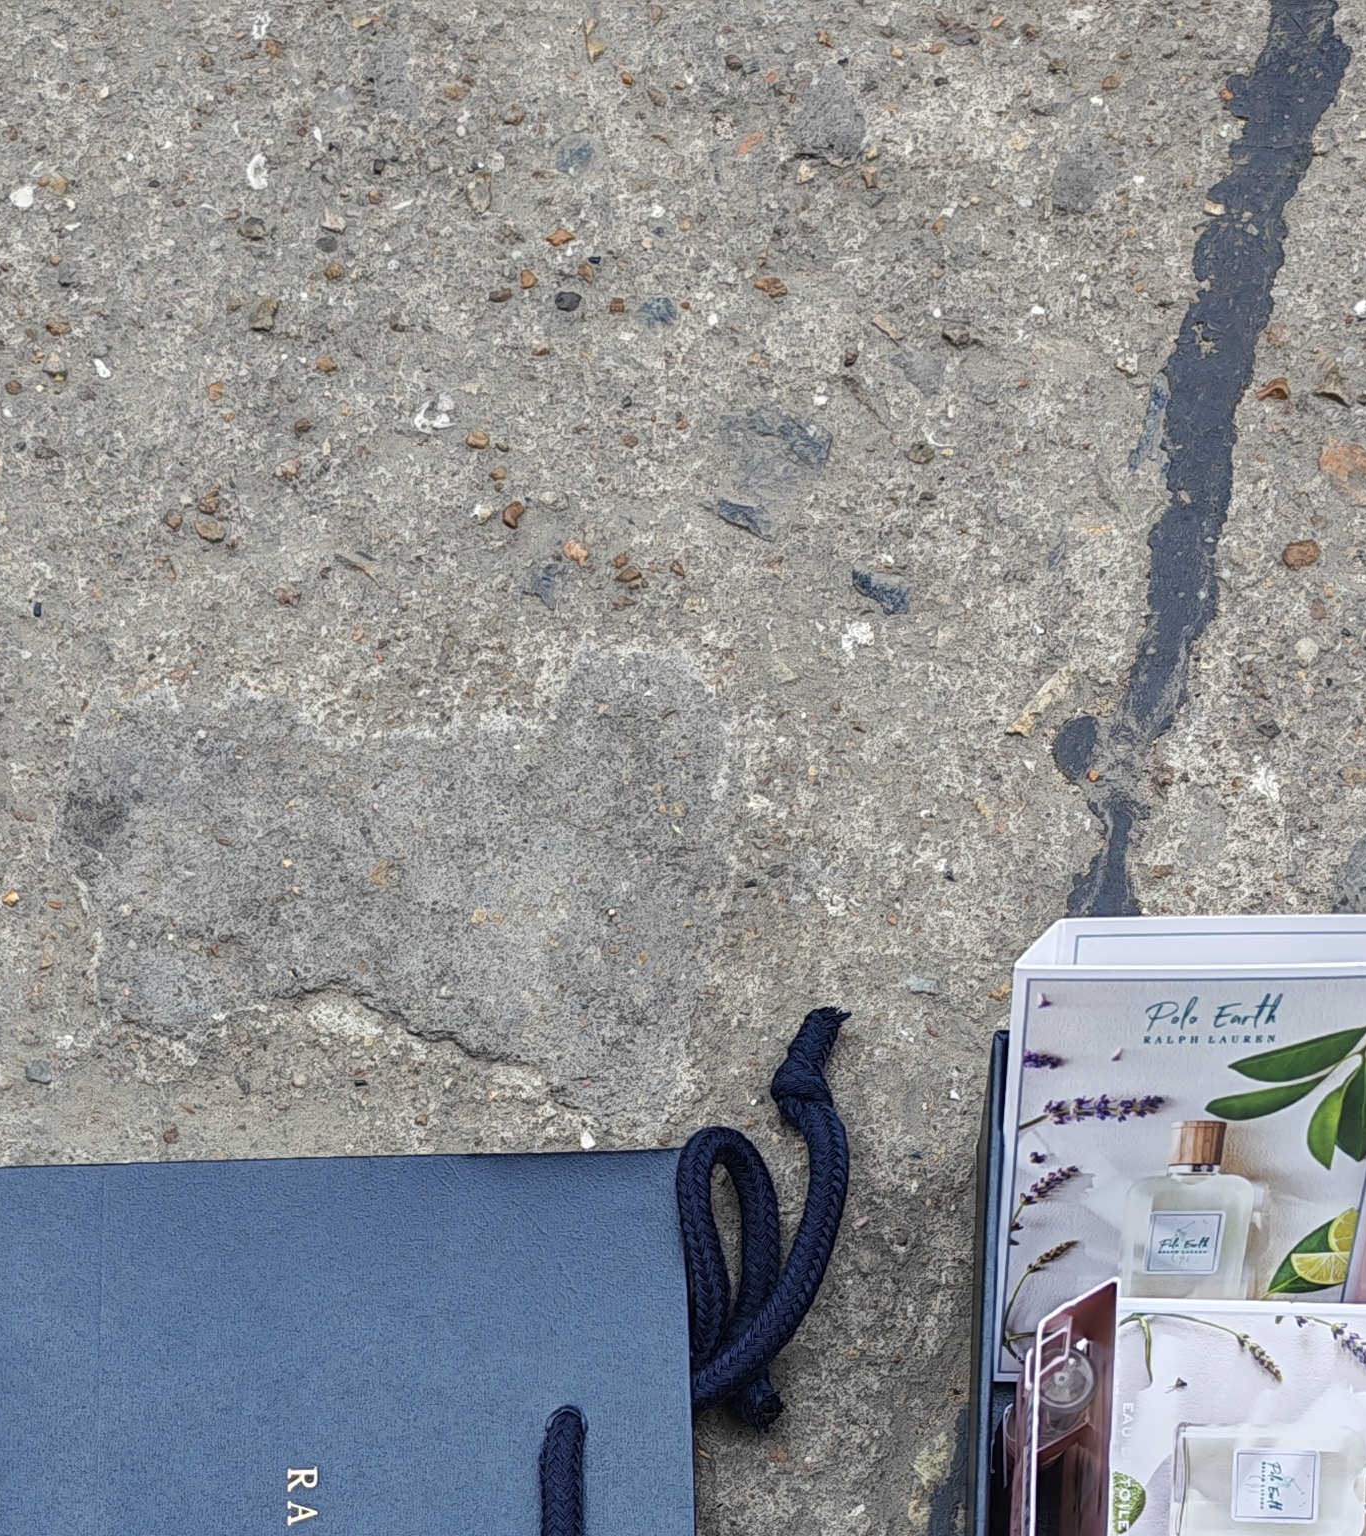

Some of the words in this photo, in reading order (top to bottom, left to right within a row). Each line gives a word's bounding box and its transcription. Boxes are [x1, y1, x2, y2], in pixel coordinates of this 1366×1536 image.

[1145, 996, 1199, 1031] Polo
[1213, 993, 1284, 1028] Earth
[1143, 1035, 1200, 1045] RALPH
[1207, 1034, 1277, 1044] LAUREN
